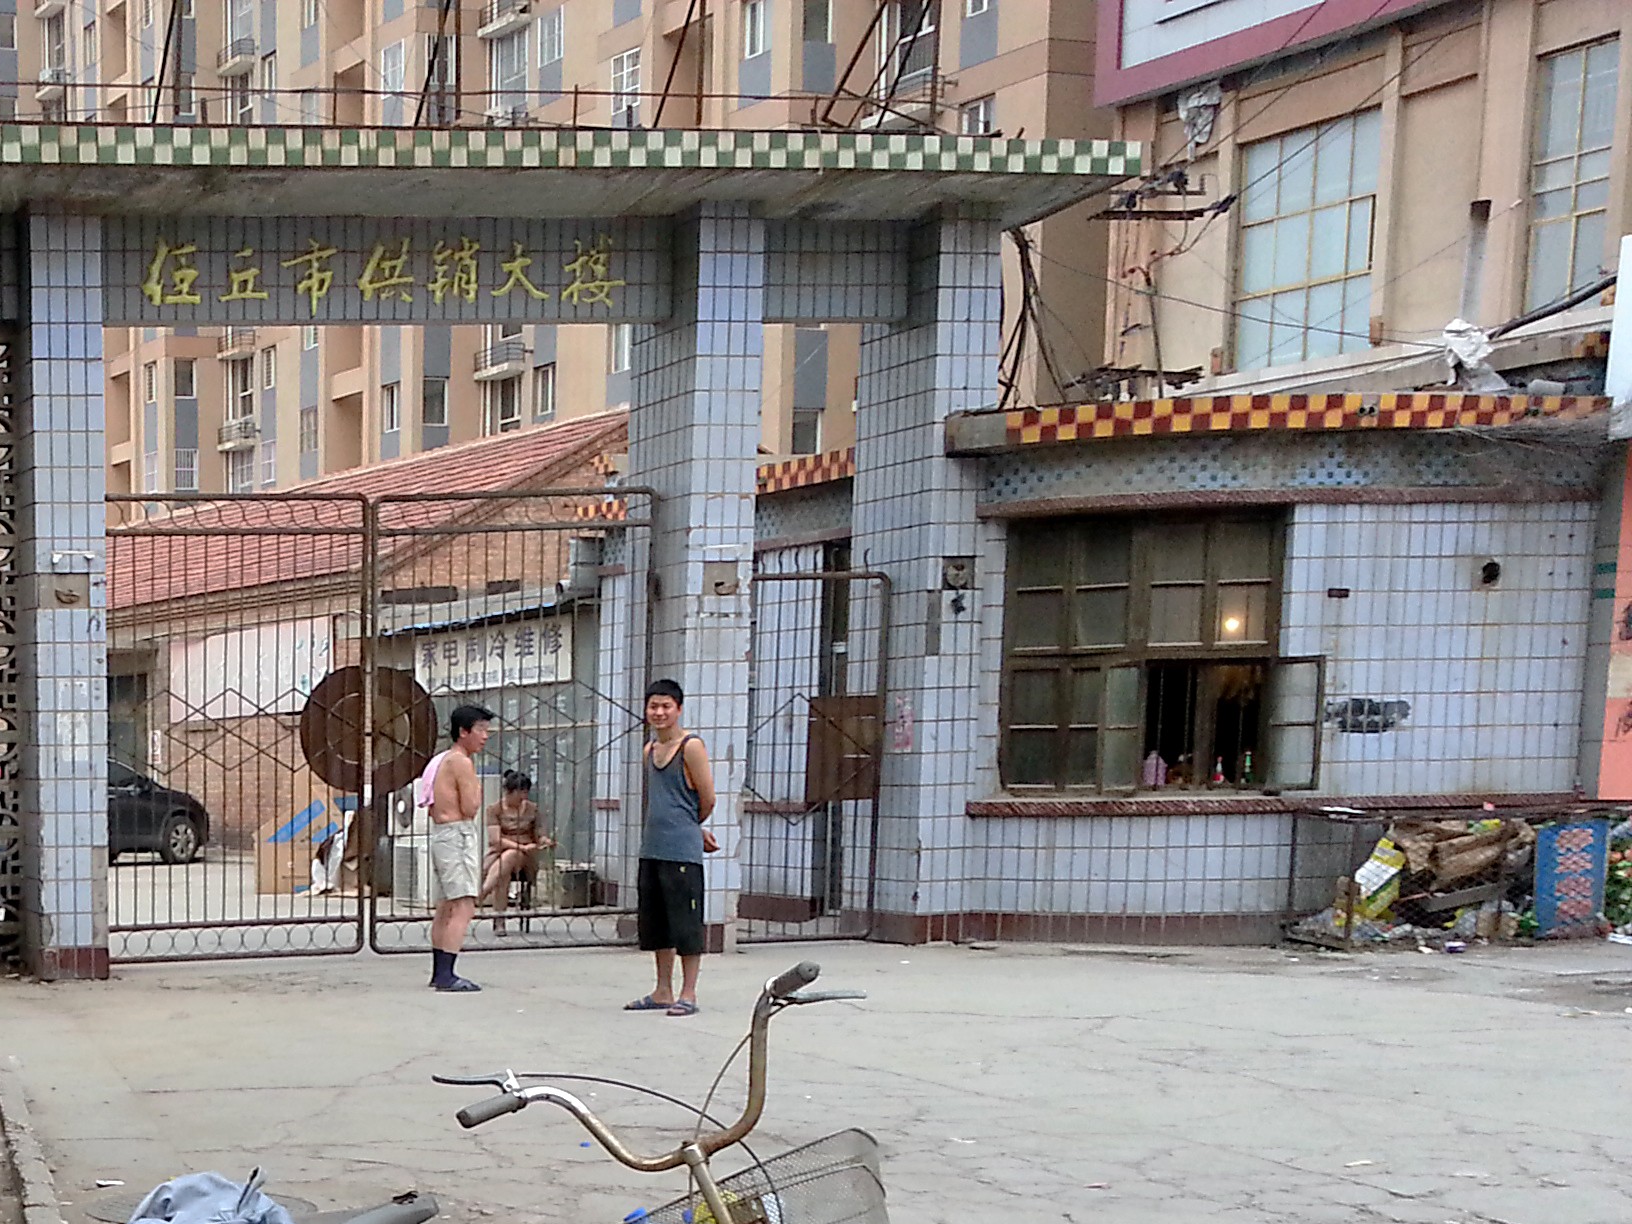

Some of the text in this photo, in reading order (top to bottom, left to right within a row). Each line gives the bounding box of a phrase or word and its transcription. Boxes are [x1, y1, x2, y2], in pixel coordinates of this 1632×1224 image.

[141, 234, 625, 317] 任丘市供销大楼
